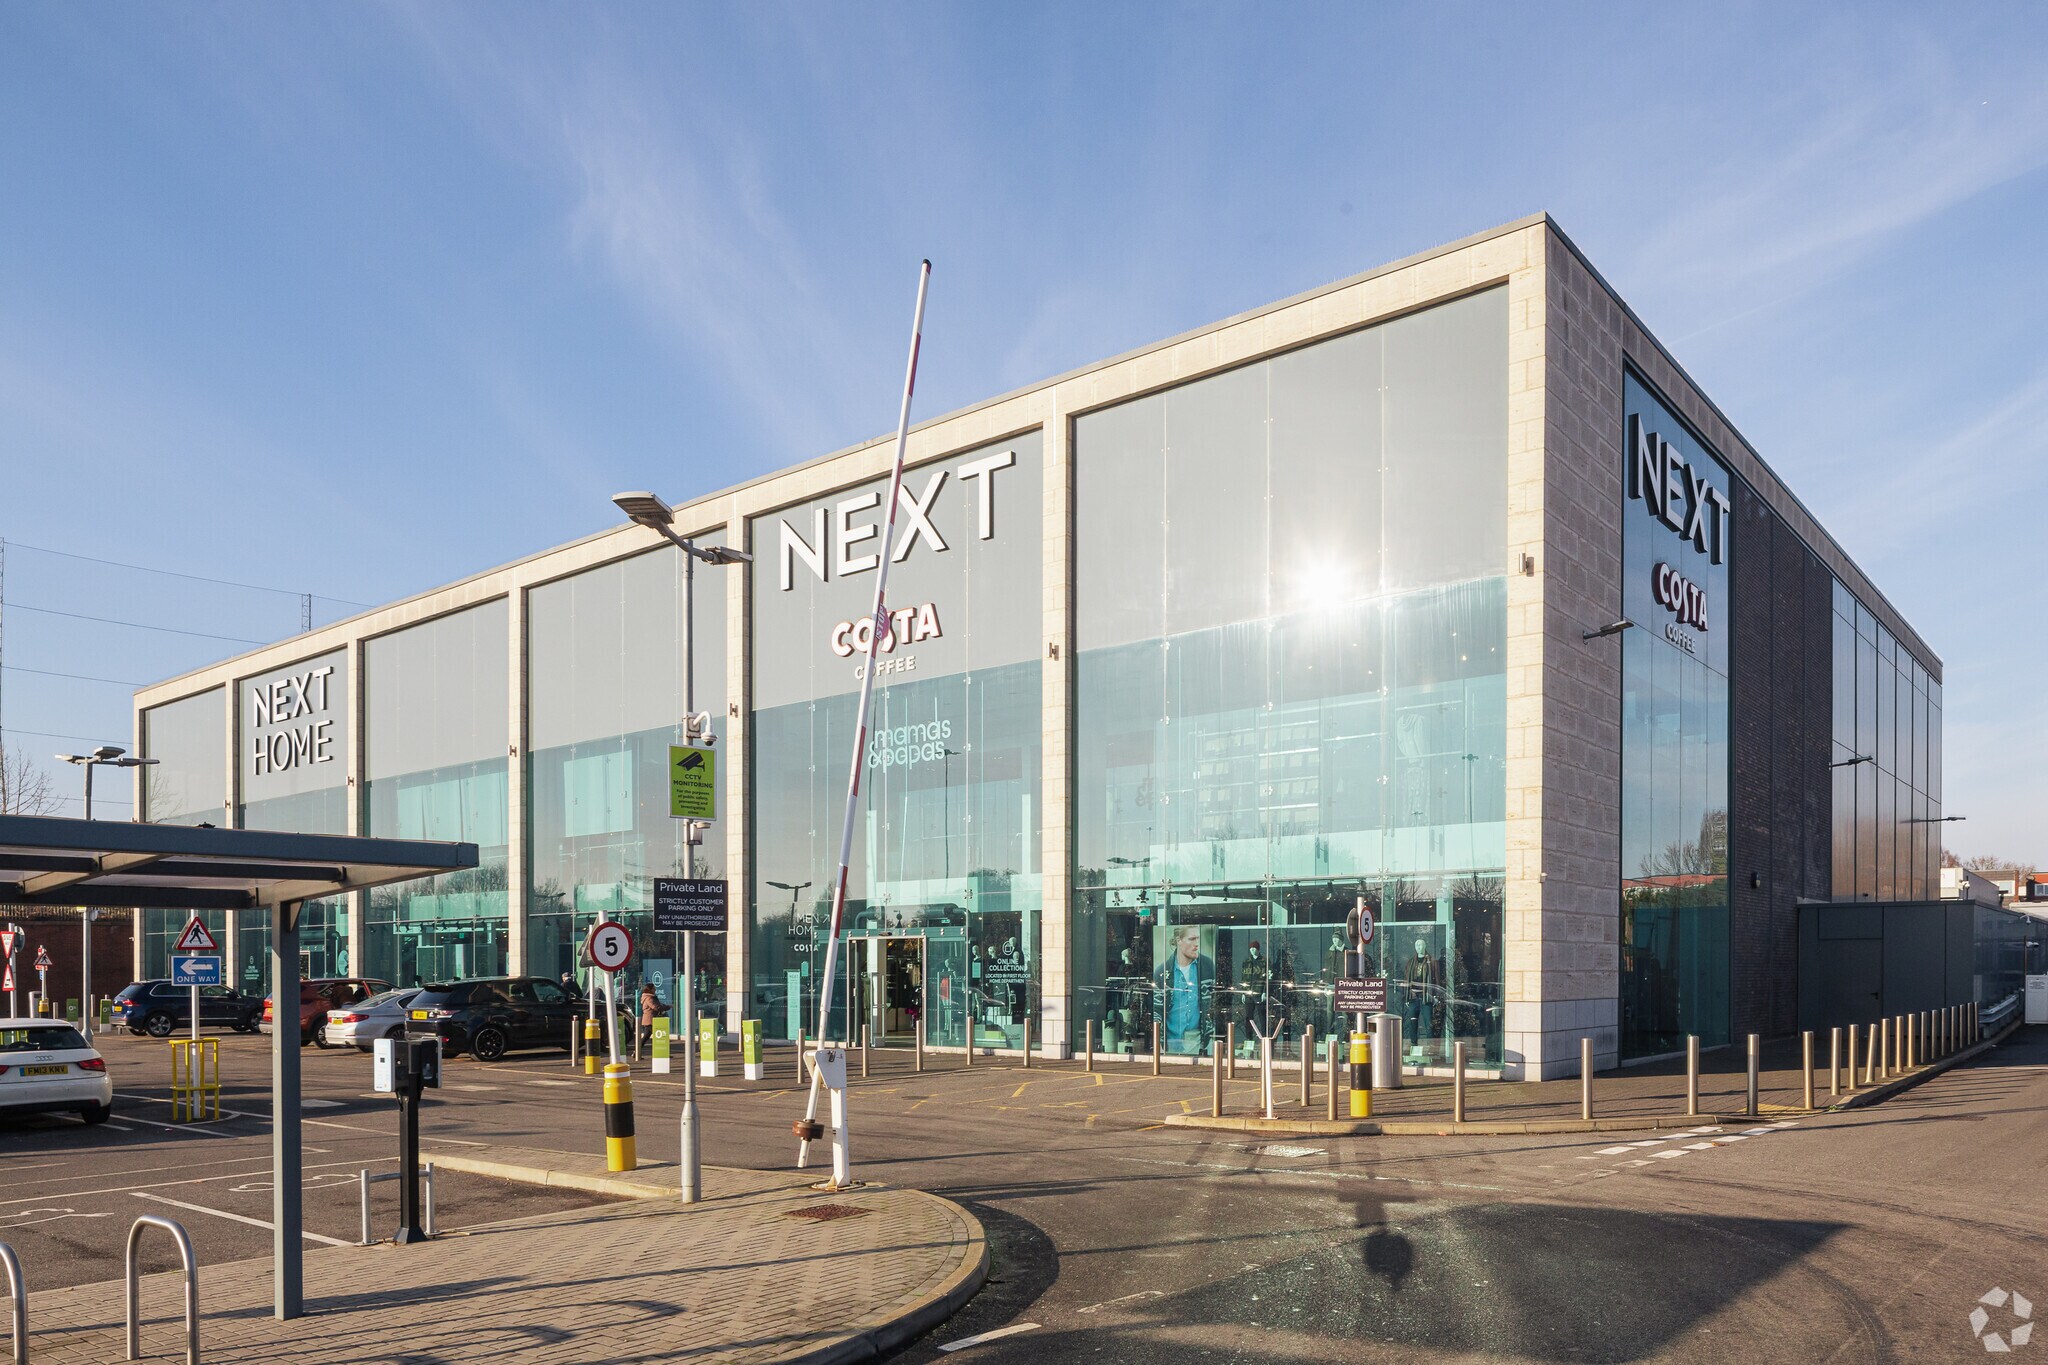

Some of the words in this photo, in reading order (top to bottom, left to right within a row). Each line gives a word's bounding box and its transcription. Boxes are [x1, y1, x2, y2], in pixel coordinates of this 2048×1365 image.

[1628, 412, 1731, 565] NEXT
[780, 450, 1016, 592] NEXT
[1651, 562, 1709, 631] COSTA
[1665, 623, 1697, 653] COFFEE
[854, 655, 917, 681] CFFEE
[253, 665, 335, 728] NEXT
[874, 719, 952, 749] mamas
[253, 719, 334, 776] HOME
[673, 779, 713, 789] MONITORING
[660, 882, 696, 893] Private
[698, 883, 723, 893] Land
[668, 904, 697, 912] PARKING
[796, 912, 819, 924] MEN
[1364, 917, 1370, 933] 5
[605, 936, 619, 957] 5
[996, 957, 1019, 965] ONLINE
[176, 975, 196, 983] ONE
[198, 975, 217, 983] WAY
[1364, 980, 1383, 988] Land
